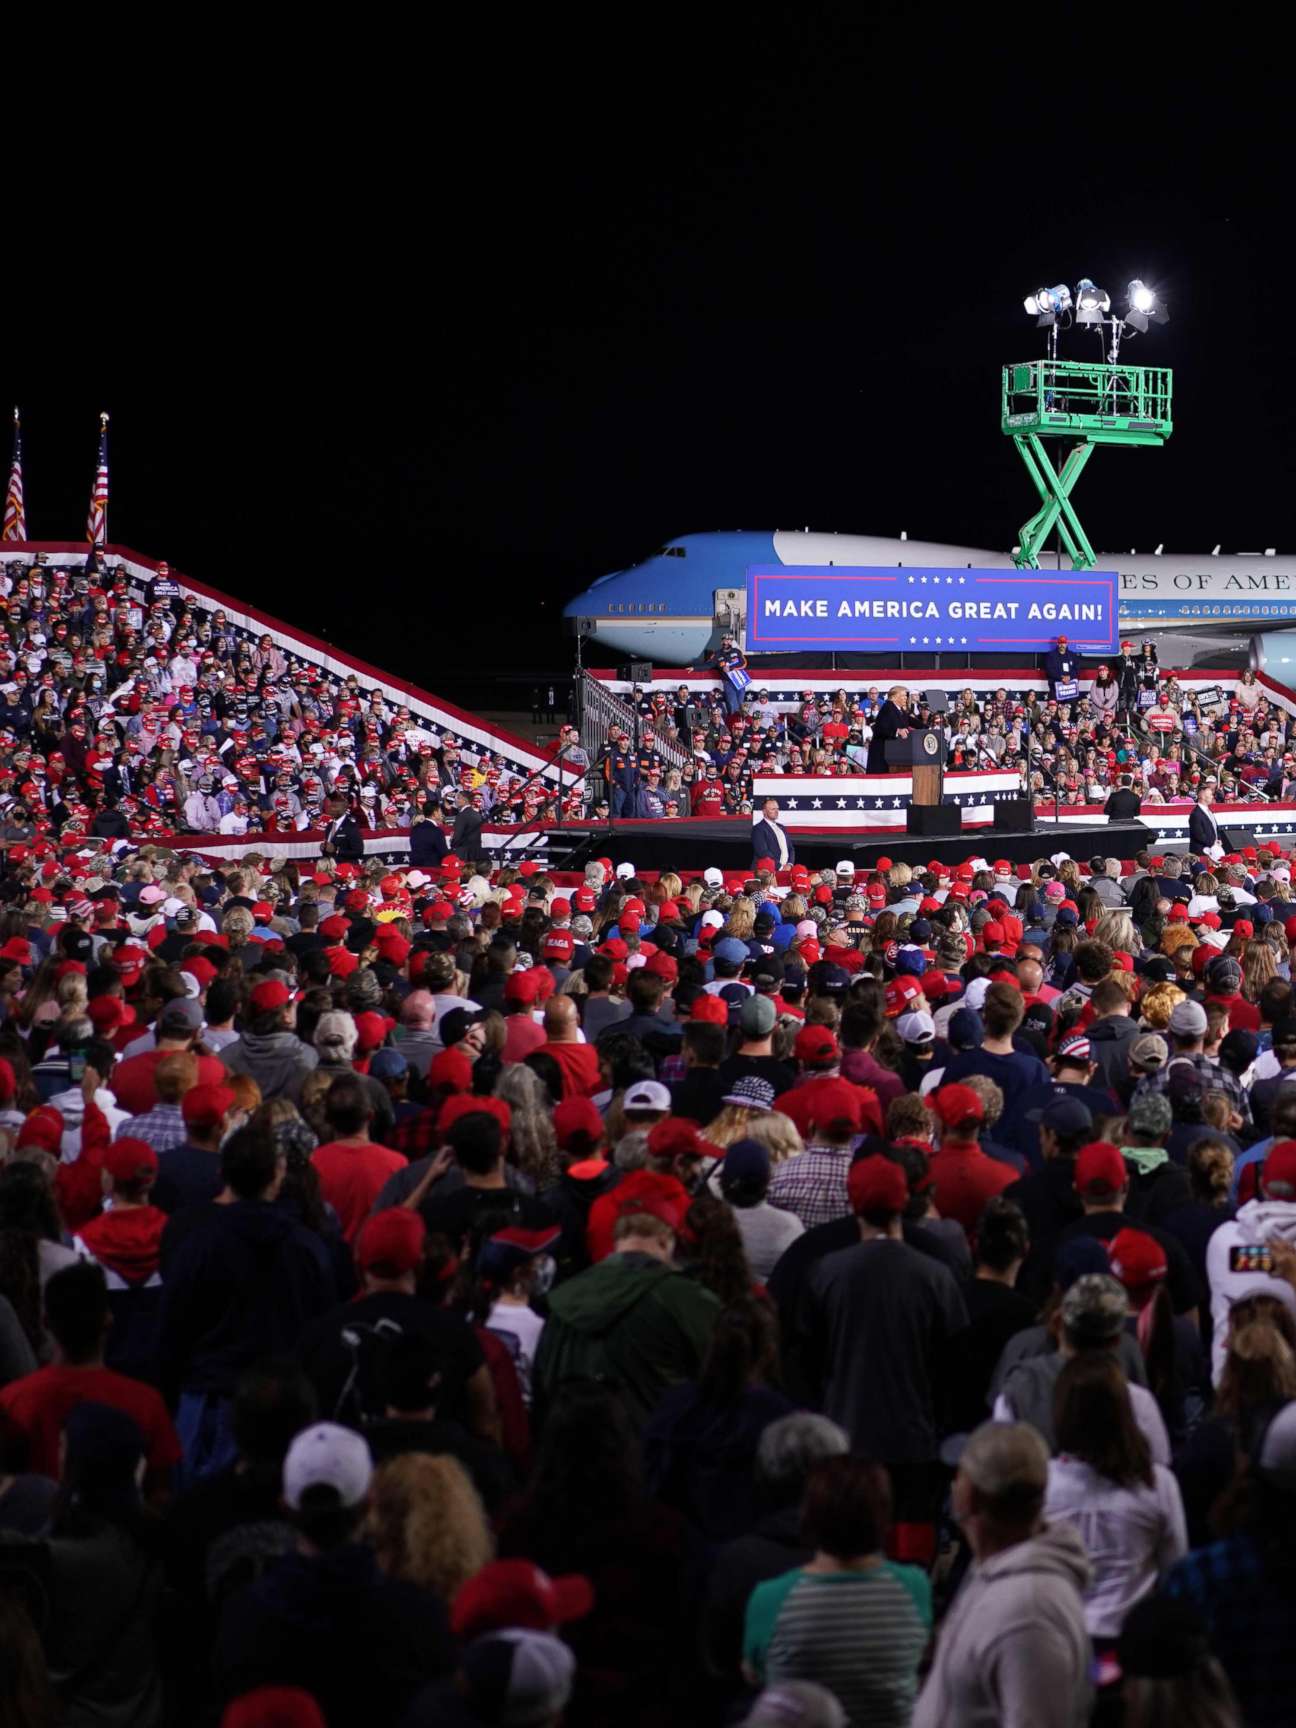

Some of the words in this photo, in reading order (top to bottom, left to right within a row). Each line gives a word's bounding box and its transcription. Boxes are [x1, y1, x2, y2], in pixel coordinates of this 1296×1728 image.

[1173, 574, 1214, 590] OF
[765, 599, 829, 617] MAKE
[837, 600, 940, 619] AMERICA
[948, 602, 1020, 620] GREAT
[1027, 603, 1103, 621] AGAIN!
